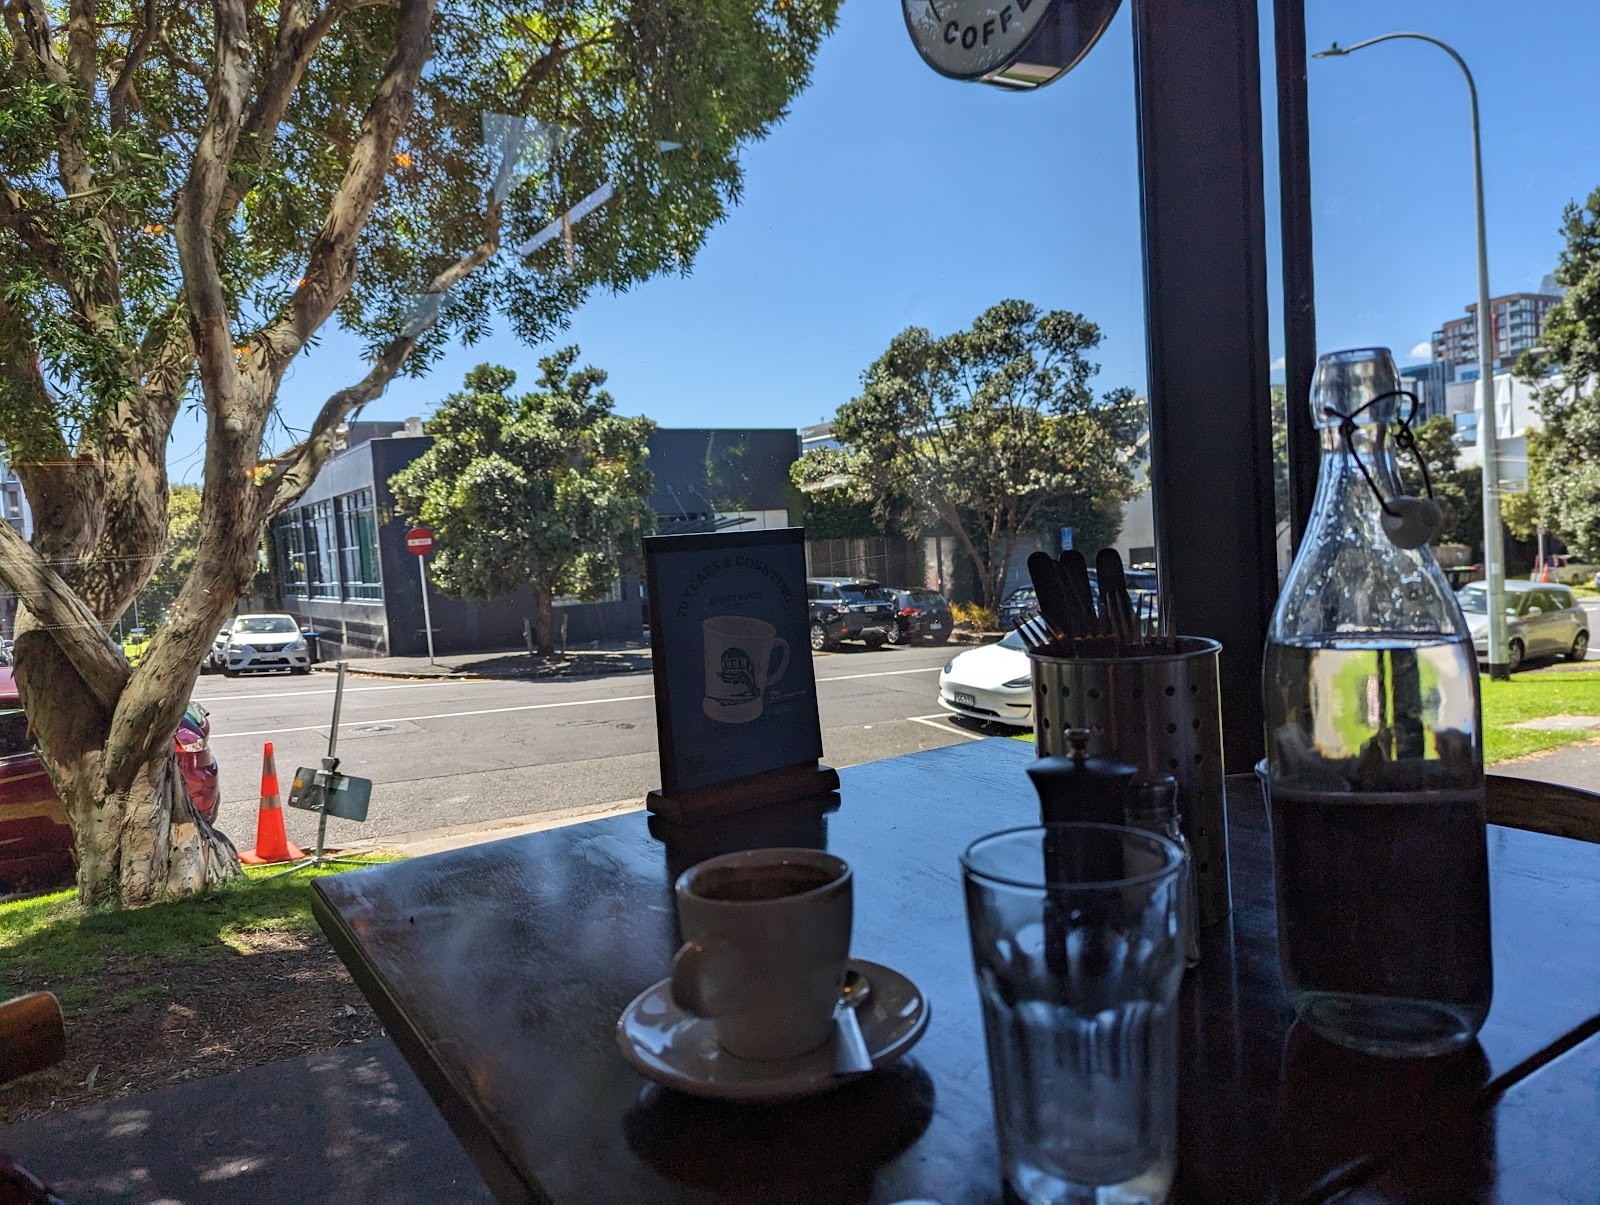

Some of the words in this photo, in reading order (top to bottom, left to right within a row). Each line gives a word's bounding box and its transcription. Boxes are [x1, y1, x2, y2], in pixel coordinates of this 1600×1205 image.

[683, 560, 721, 597] YEARS
[723, 557, 734, 569] &
[735, 555, 793, 604] COUNTING
